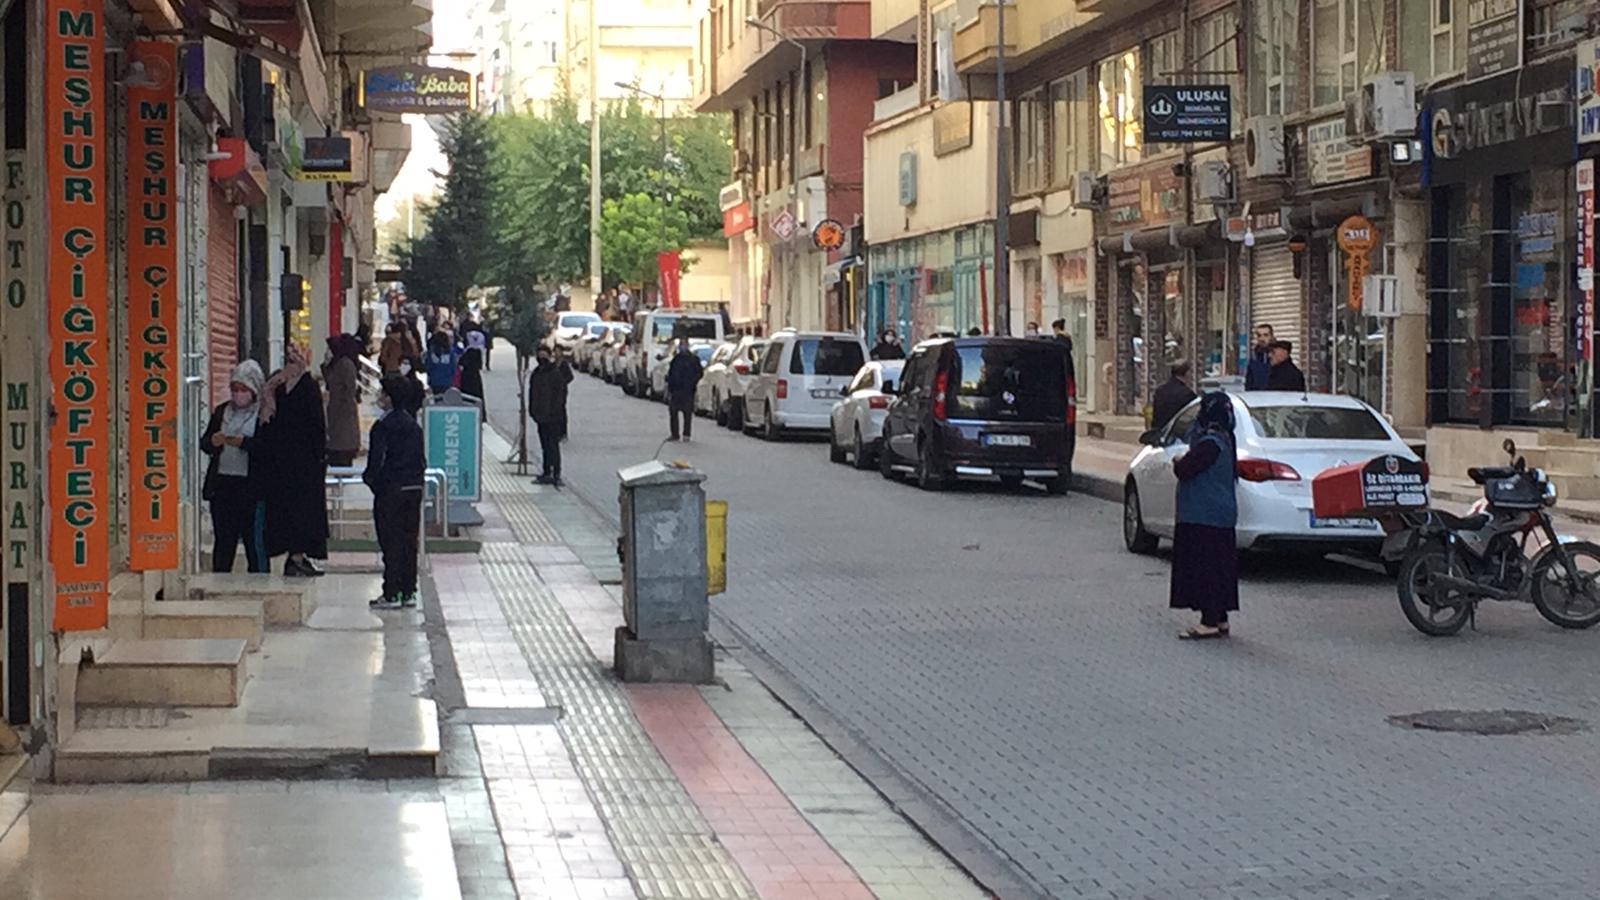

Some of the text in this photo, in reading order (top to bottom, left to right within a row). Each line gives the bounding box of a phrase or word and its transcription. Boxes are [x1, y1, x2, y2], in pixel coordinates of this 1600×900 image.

[58, 10, 95, 206] MEŞHUR
[417, 74, 469, 95] Baba
[1176, 90, 1227, 103] ULUSAL
[139, 100, 169, 248] MEŞHUR
[6, 160, 29, 569] FOTO MURAT
[445, 412, 460, 495] SIEMENS
